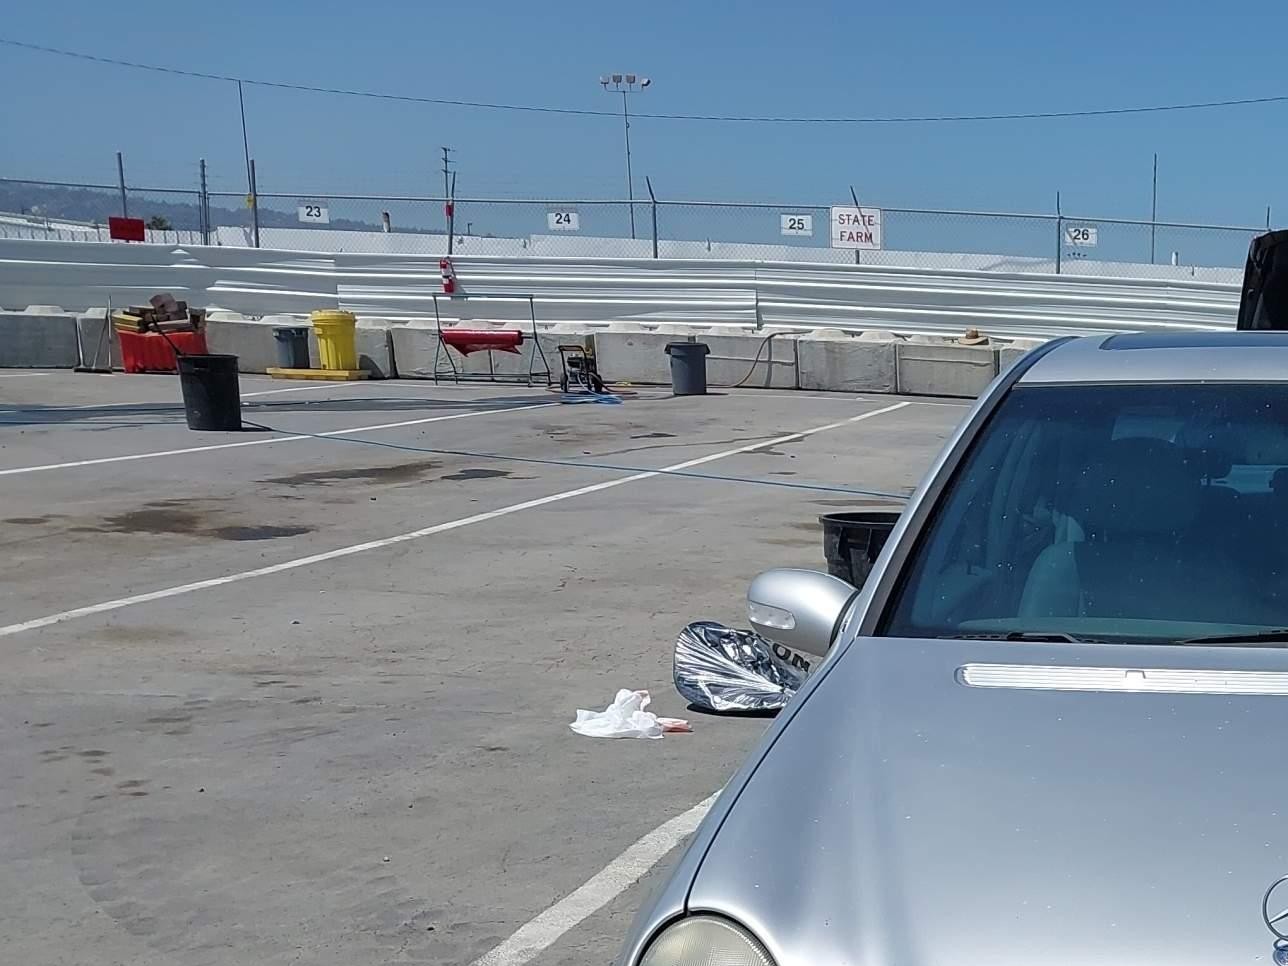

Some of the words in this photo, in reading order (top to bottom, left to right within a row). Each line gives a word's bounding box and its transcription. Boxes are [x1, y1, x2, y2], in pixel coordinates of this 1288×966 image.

[305, 205, 322, 218] 23
[554, 212, 571, 225] 24
[788, 217, 805, 230] 25
[838, 213, 876, 226] STATE
[839, 230, 874, 243] FARM
[1073, 228, 1090, 241] 26
